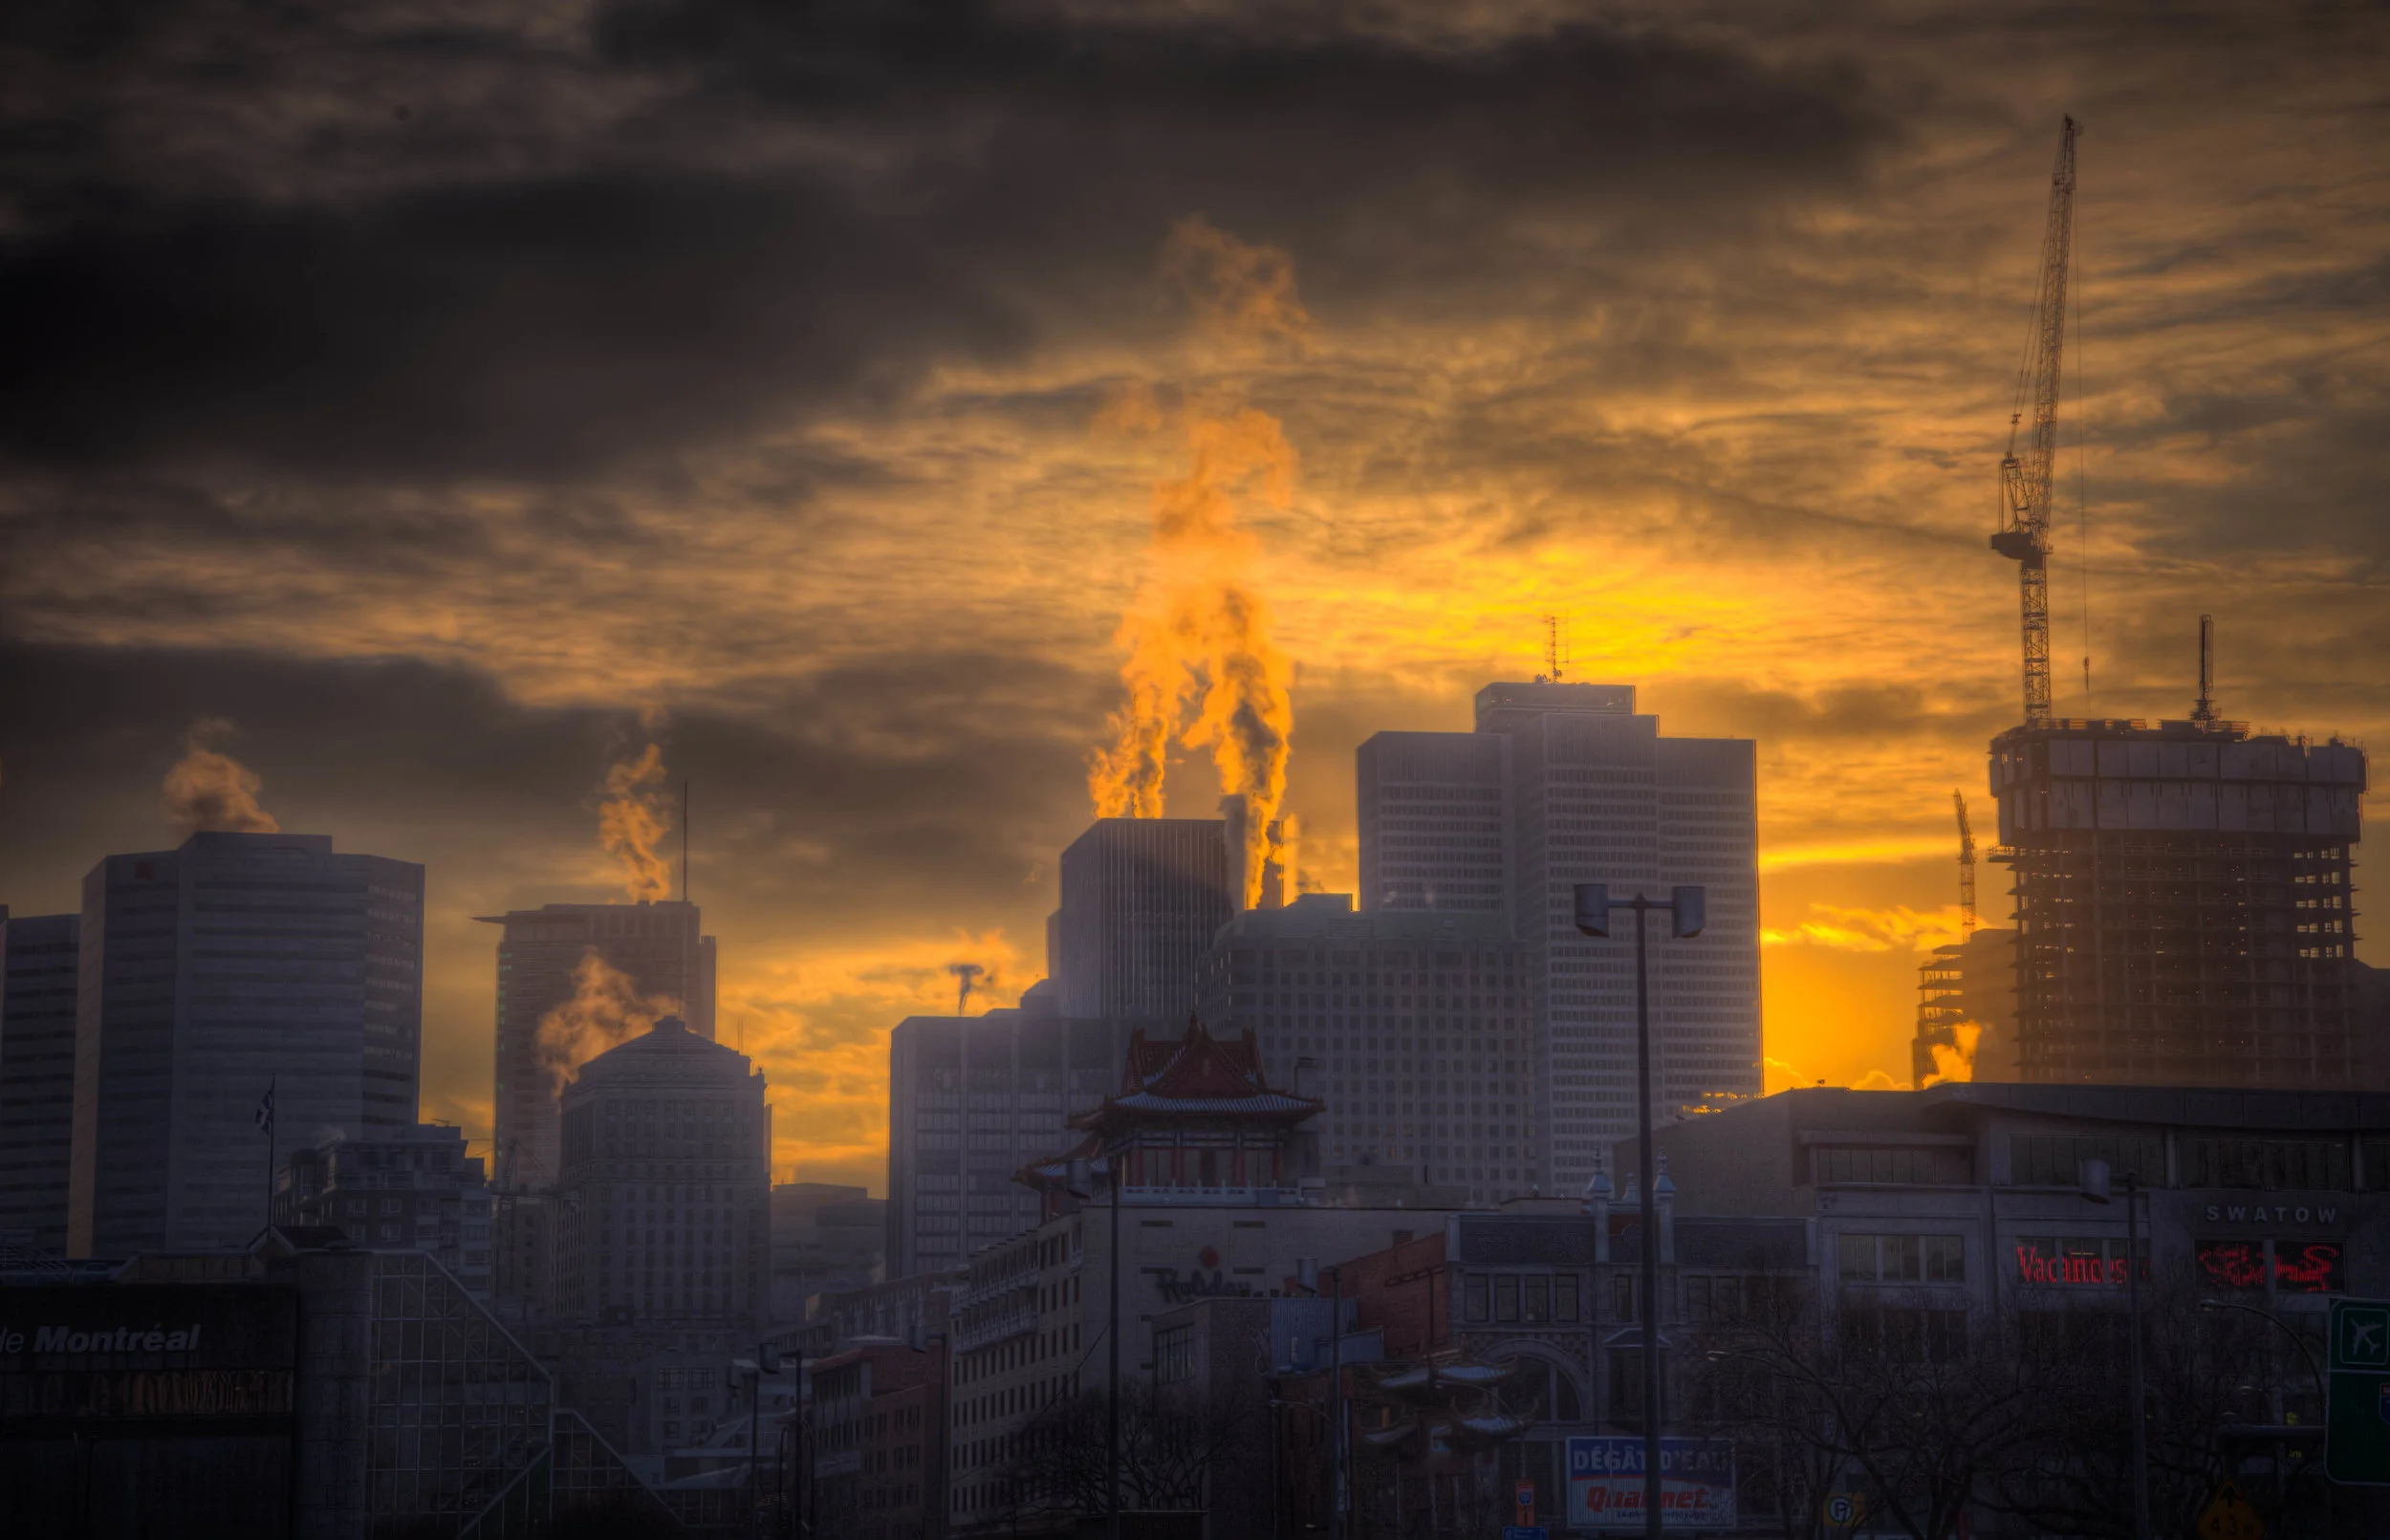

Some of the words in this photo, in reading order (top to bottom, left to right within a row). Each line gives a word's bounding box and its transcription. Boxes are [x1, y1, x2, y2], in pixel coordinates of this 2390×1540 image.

[2206, 1205, 2336, 1223] SWATOW
[33, 1323, 202, 1353] Montréal
[1587, 1486, 1708, 1512] Qualnet
